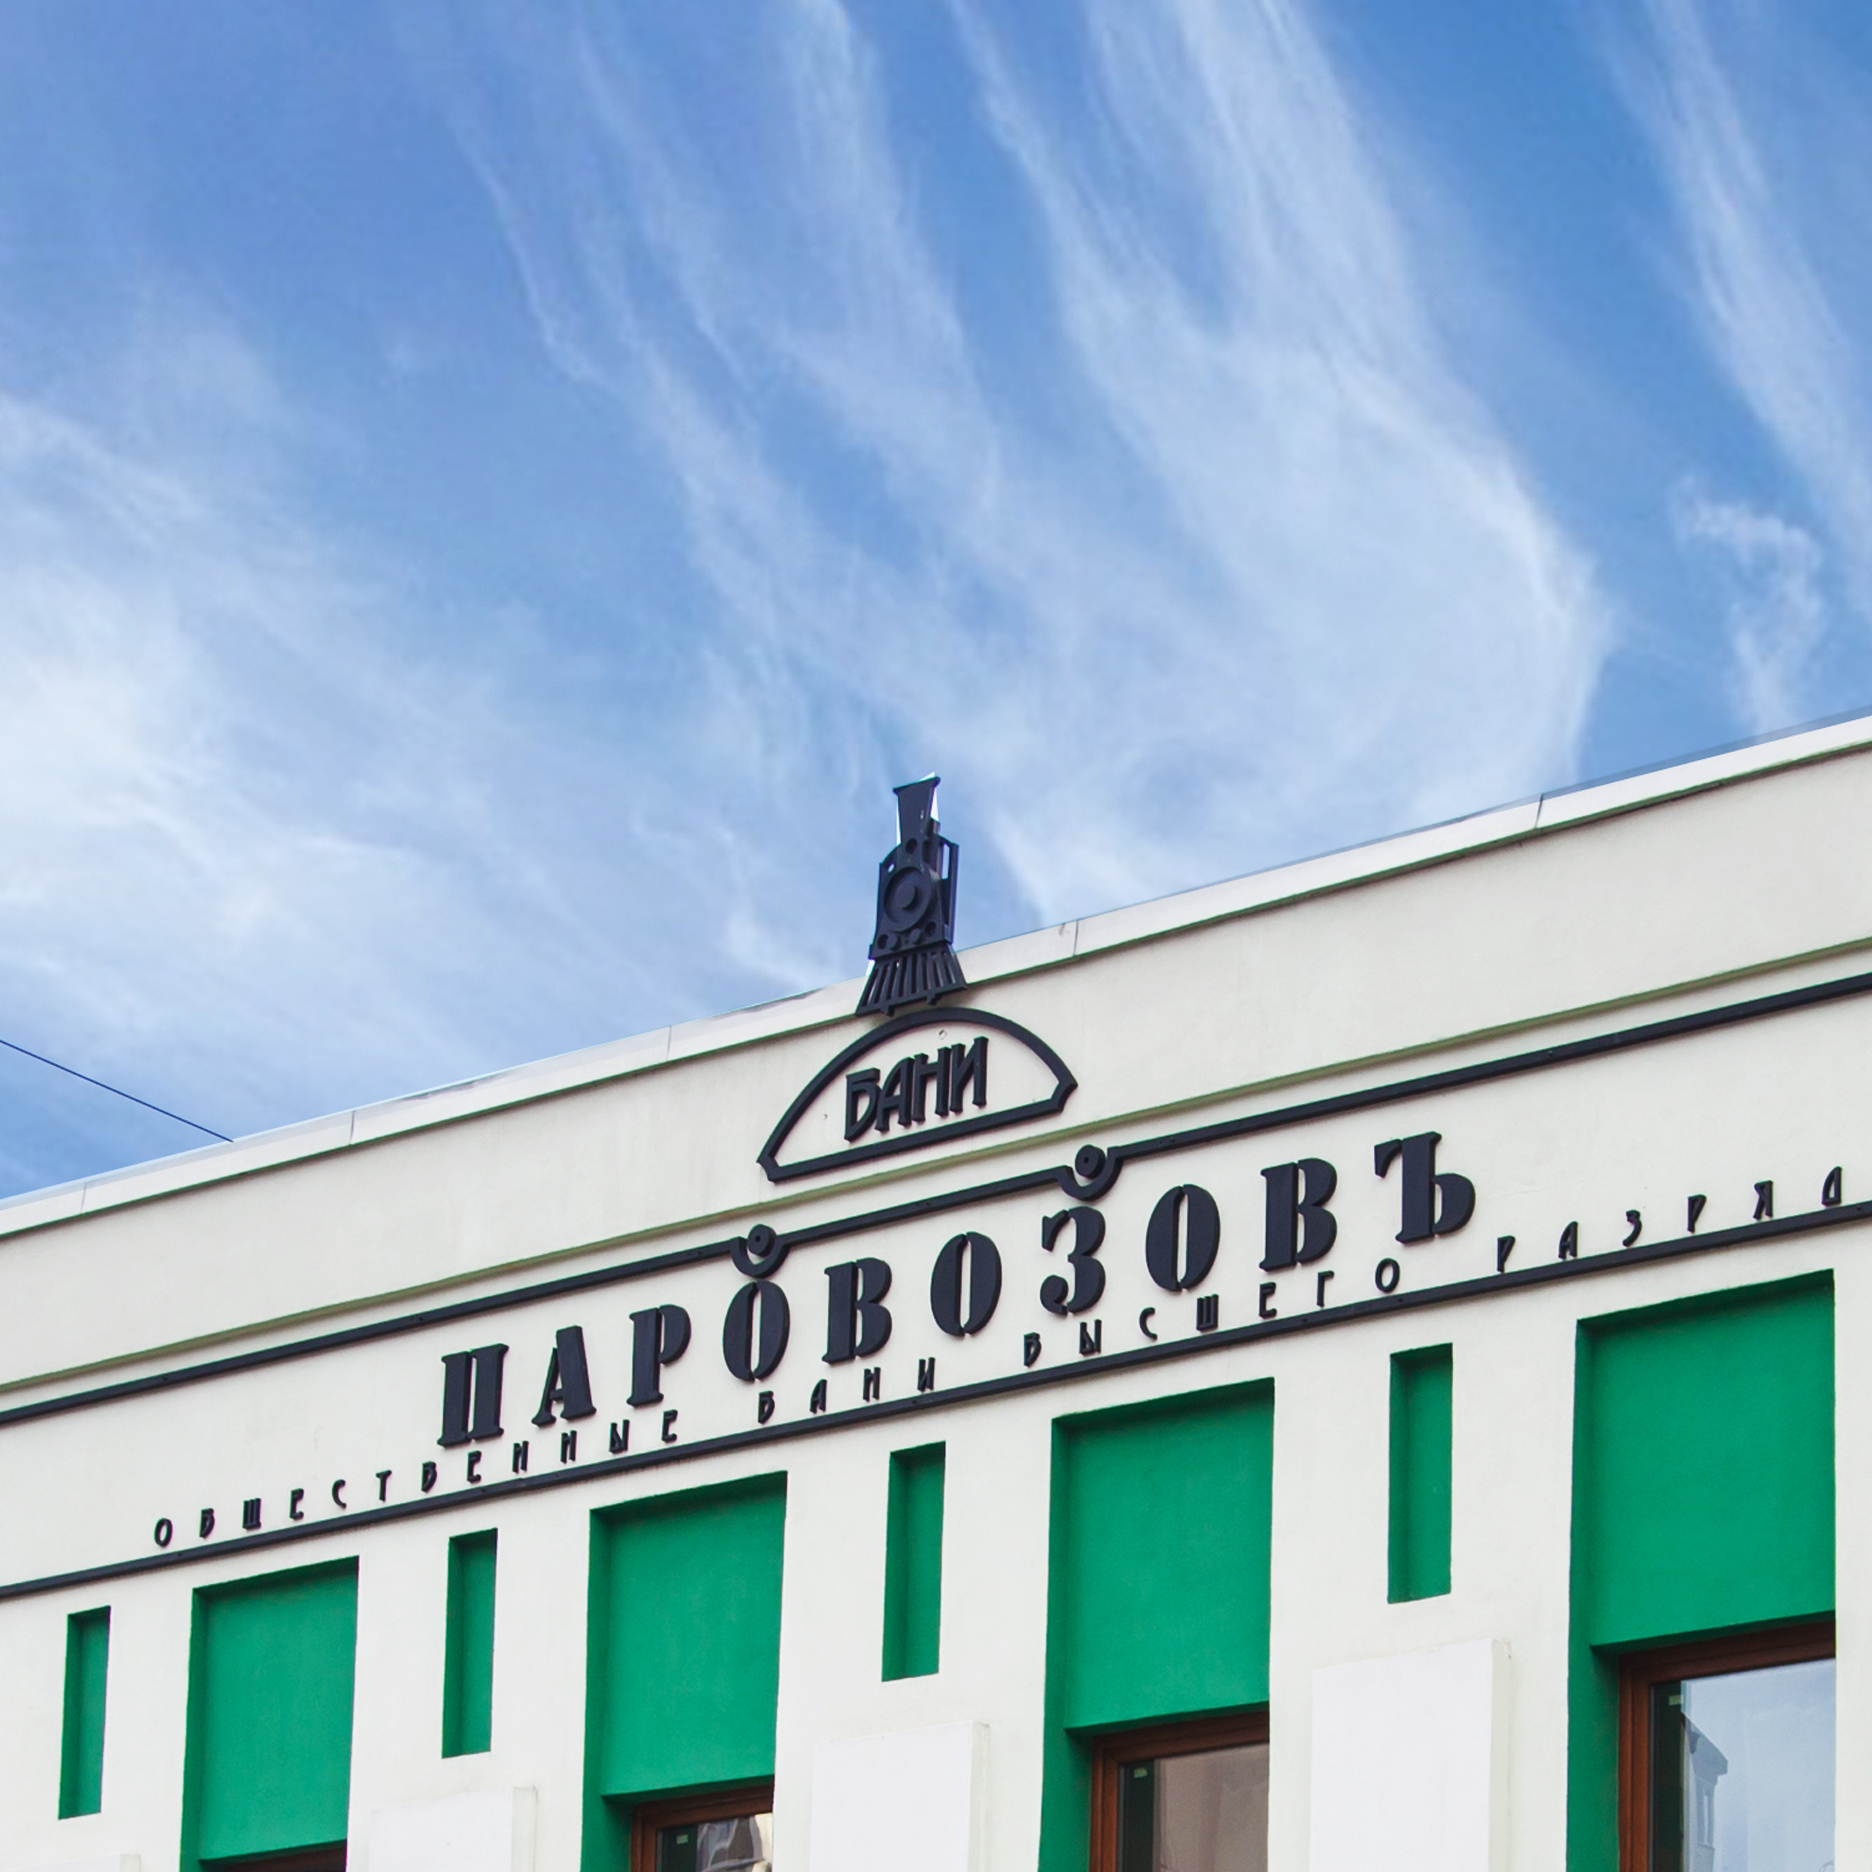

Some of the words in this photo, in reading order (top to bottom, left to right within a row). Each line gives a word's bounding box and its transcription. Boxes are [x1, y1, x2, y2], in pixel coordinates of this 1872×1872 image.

[844, 1036, 989, 1142] БАНИ
[437, 1132, 1476, 1448] ПАРОВОЗОВЪ
[757, 1357, 936, 1424] БАНИ
[1023, 1257, 1401, 1367] ВЫСШЕГО
